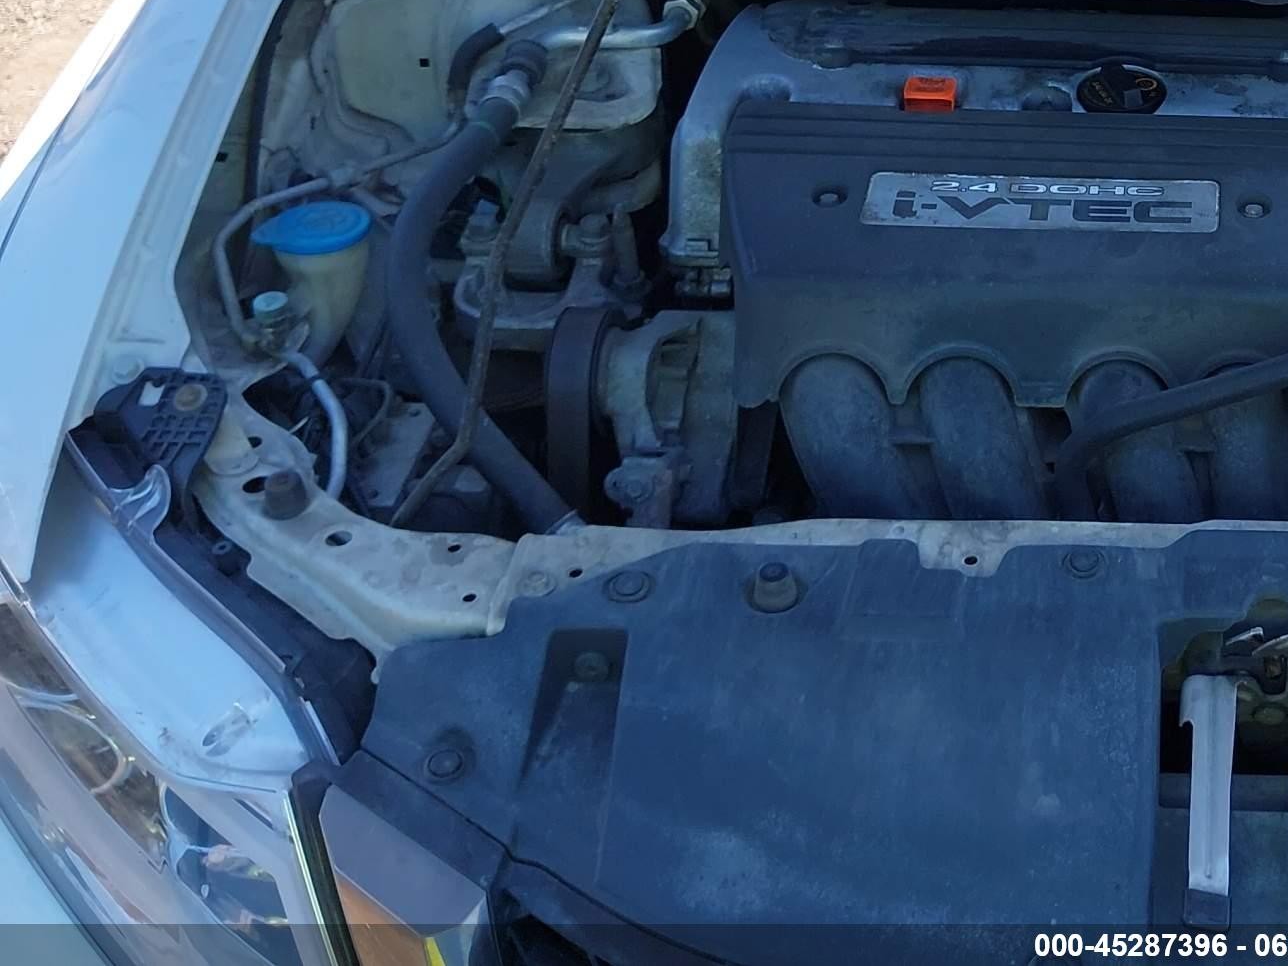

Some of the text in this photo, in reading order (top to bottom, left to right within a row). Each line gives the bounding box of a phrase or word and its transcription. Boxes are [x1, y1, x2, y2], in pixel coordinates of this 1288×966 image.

[930, 180, 1165, 196] 2.4 DOHC
[892, 190, 1193, 224] i-VTEC
